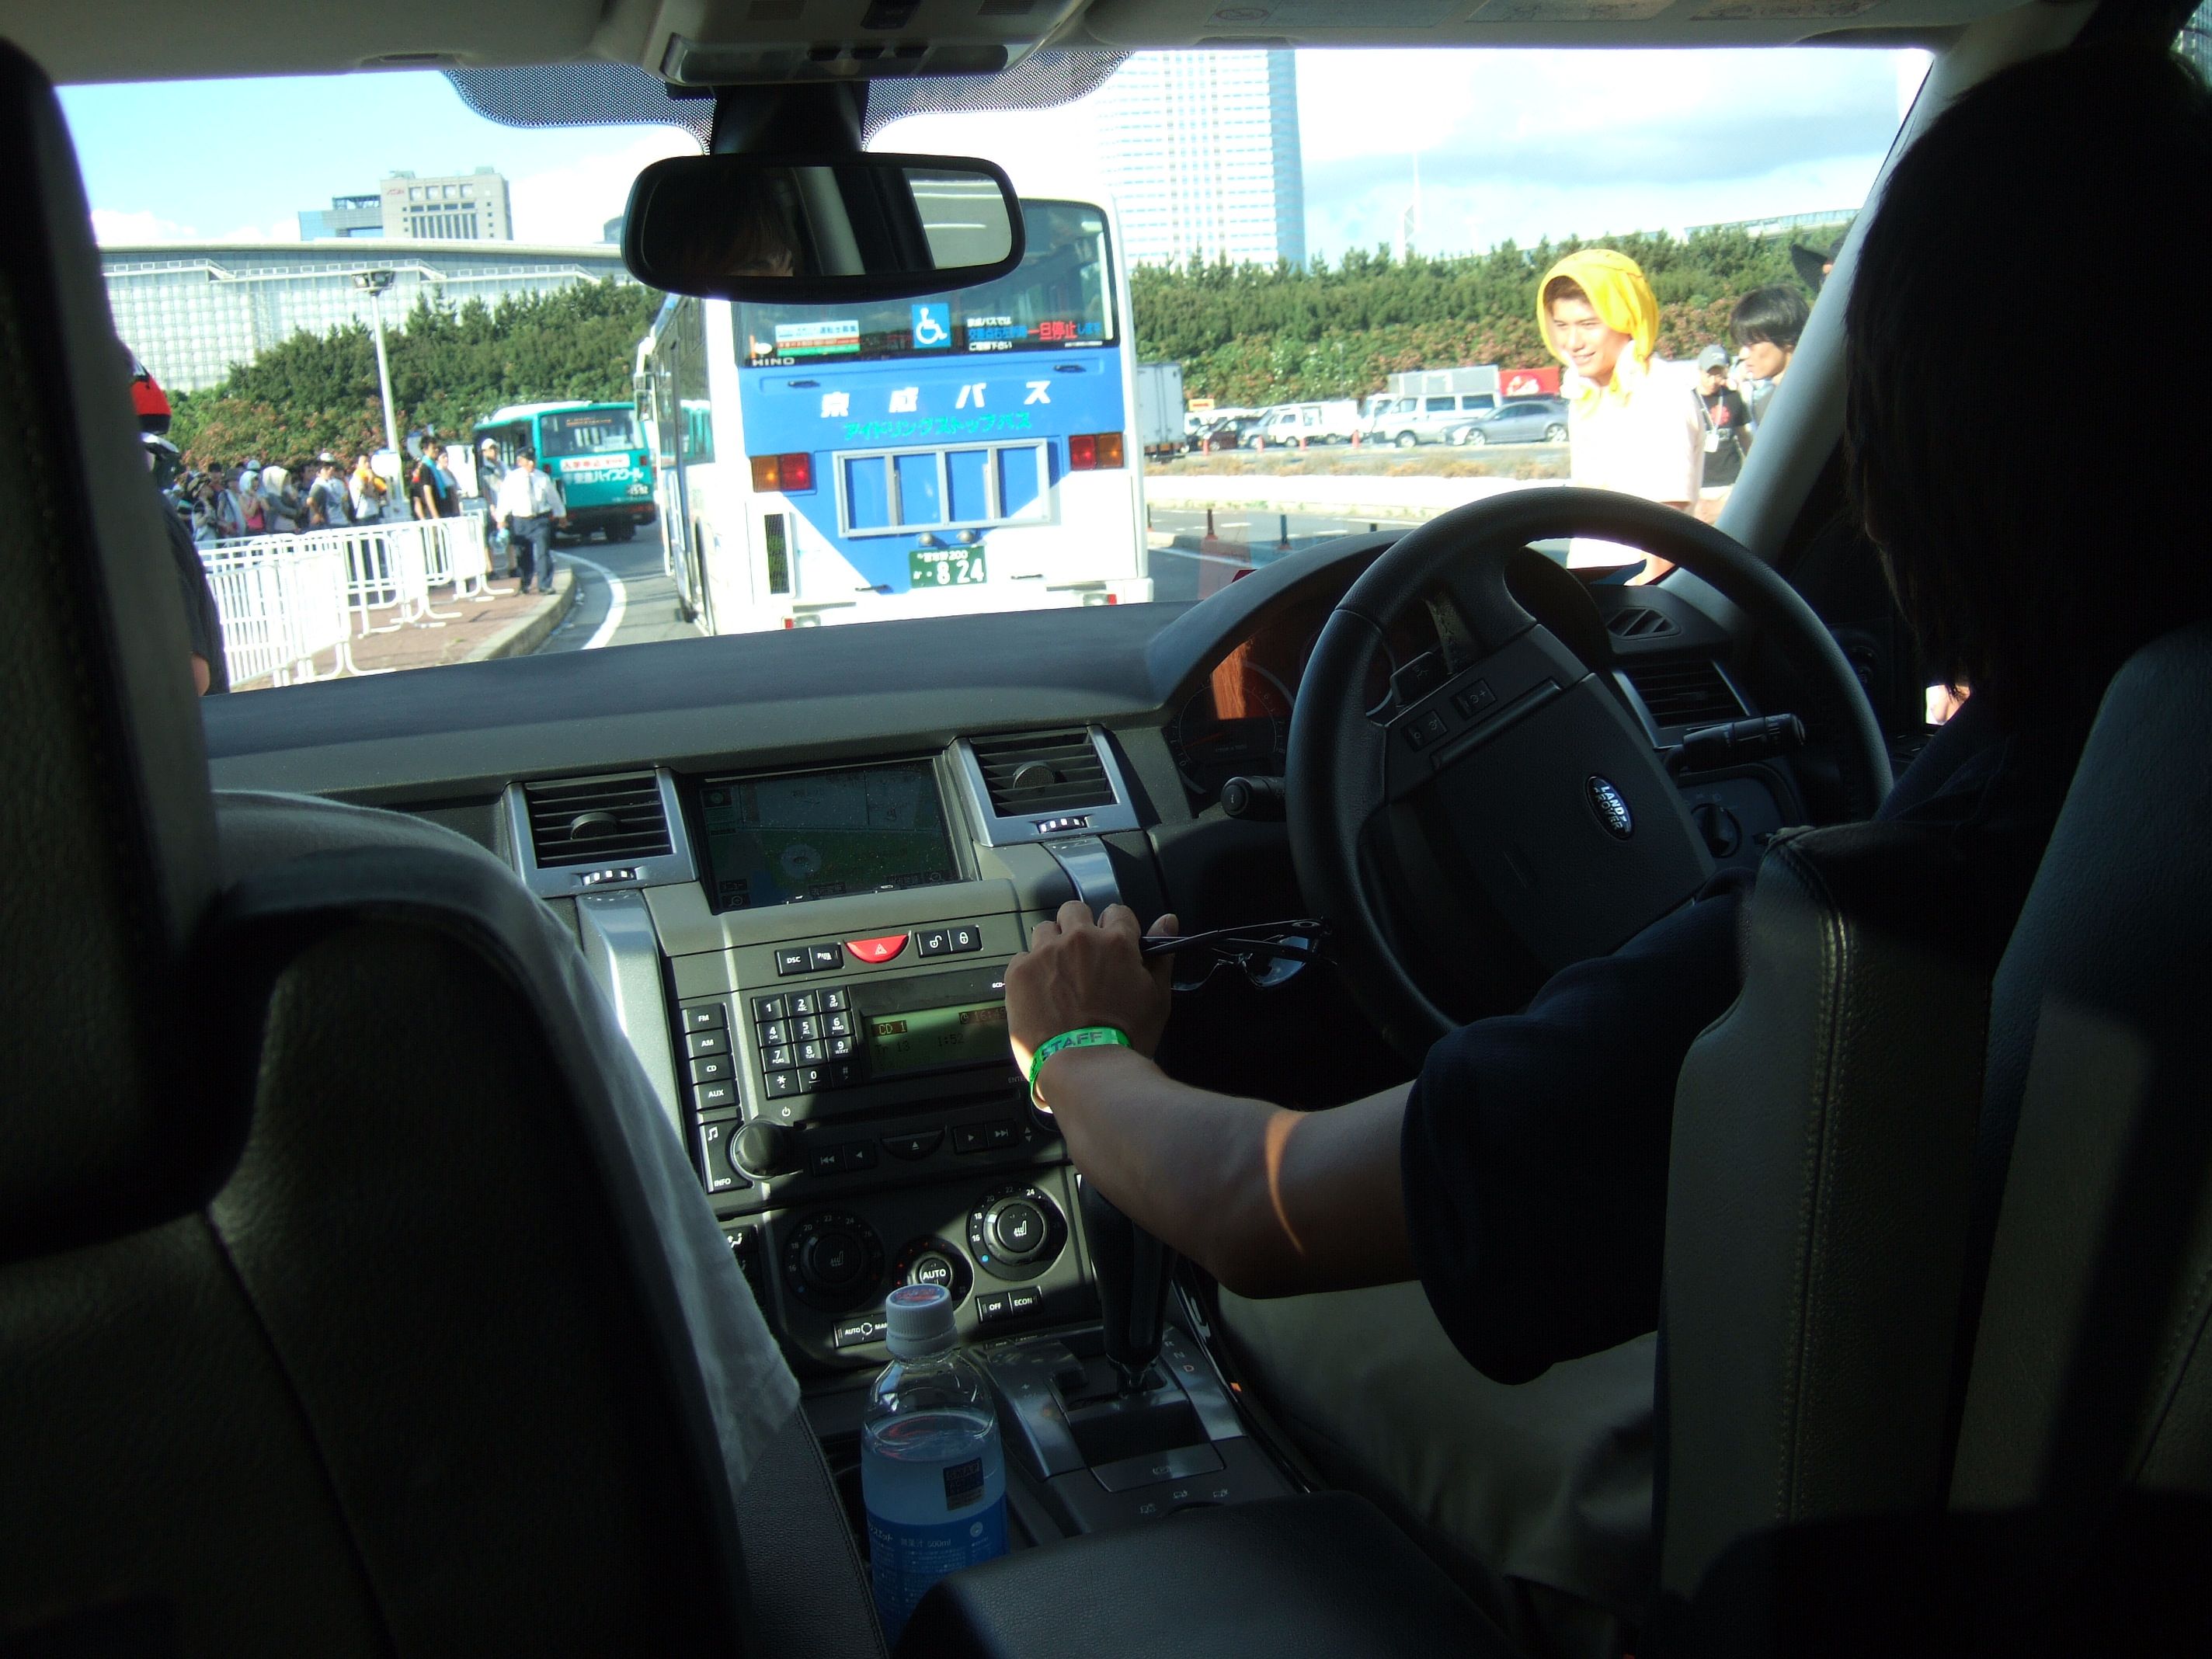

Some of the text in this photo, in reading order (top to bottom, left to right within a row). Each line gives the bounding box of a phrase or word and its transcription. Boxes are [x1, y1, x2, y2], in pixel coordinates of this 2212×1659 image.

[752, 356, 795, 367] HINO
[820, 381, 1052, 418] 京成バス
[844, 412, 1032, 441] アイドリングストップバス
[1600, 786, 1625, 816] LAND
[1595, 793, 1623, 830] ROVER
[786, 956, 801, 965] DSC
[798, 999, 805, 1007] 2
[830, 995, 836, 1003] 3
[766, 1003, 772, 1012] 1
[698, 1014, 709, 1023] FM
[833, 1017, 840, 1026] 6
[770, 1026, 777, 1035] 4
[802, 1021, 809, 1031] 5
[878, 1020, 906, 1035] CD 1
[701, 1038, 714, 1047] AM
[837, 1041, 844, 1050] 9
[896, 1040, 910, 1052] 13
[1042, 1031, 1103, 1062] STAFF
[774, 1050, 781, 1059] 7
[805, 1045, 813, 1055] 8
[706, 1065, 717, 1073] CD
[810, 1071, 817, 1080] 0
[708, 1089, 724, 1098] AUX
[714, 1177, 732, 1187] INFO
[974, 1212, 983, 1220] 18
[972, 1233, 981, 1243] 16
[922, 1268, 947, 1281] AUTO
[1014, 1297, 1033, 1307] ECON
[989, 1303, 1002, 1312] OFF
[844, 1327, 861, 1336] AUTO
